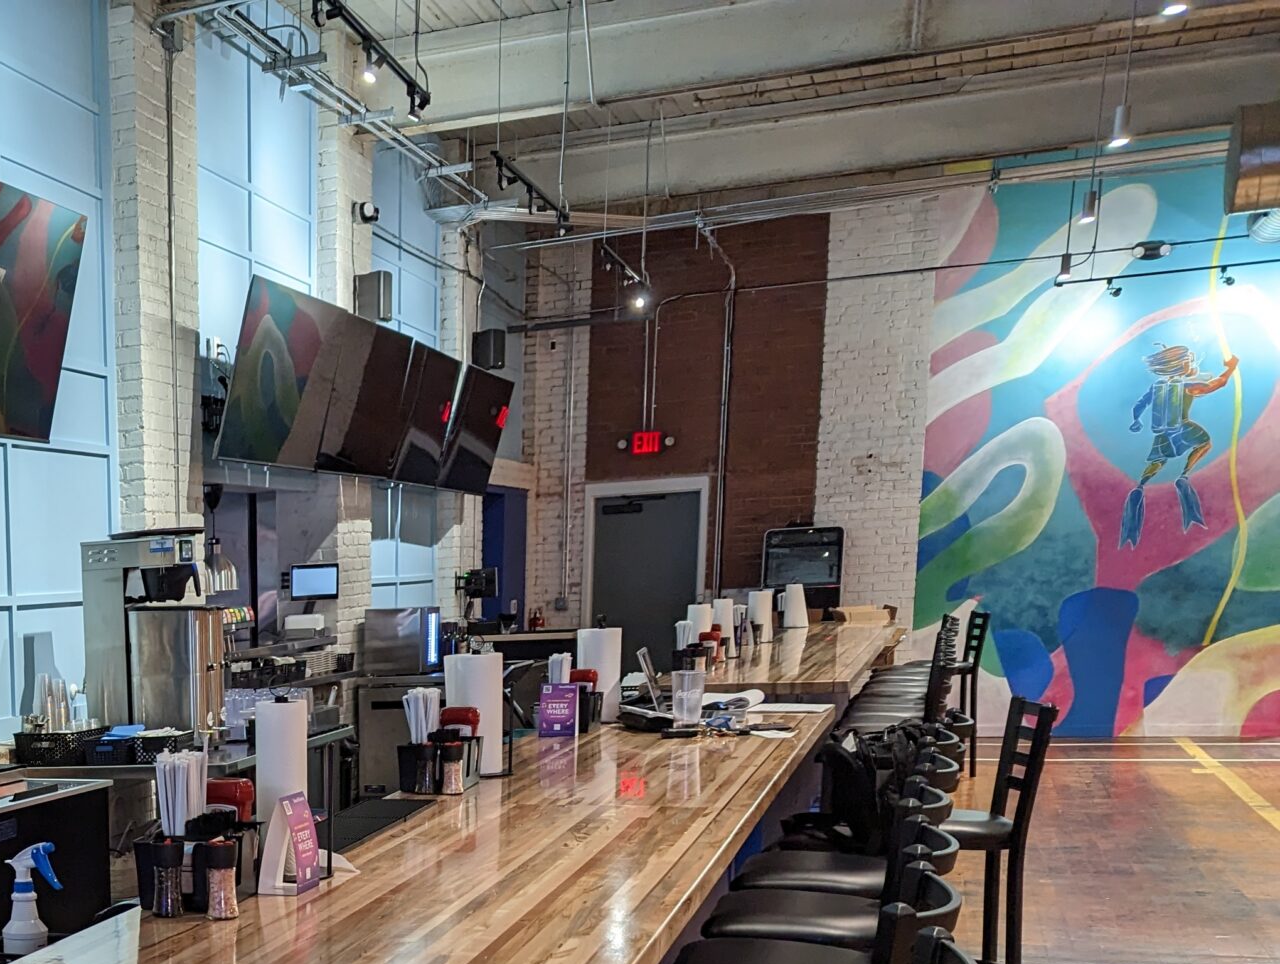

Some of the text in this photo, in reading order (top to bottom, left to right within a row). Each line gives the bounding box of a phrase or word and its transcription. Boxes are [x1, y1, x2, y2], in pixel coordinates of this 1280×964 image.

[632, 431, 661, 453] EXIT
[297, 829, 310, 842] EVERY
[298, 839, 314, 850] WHERE
